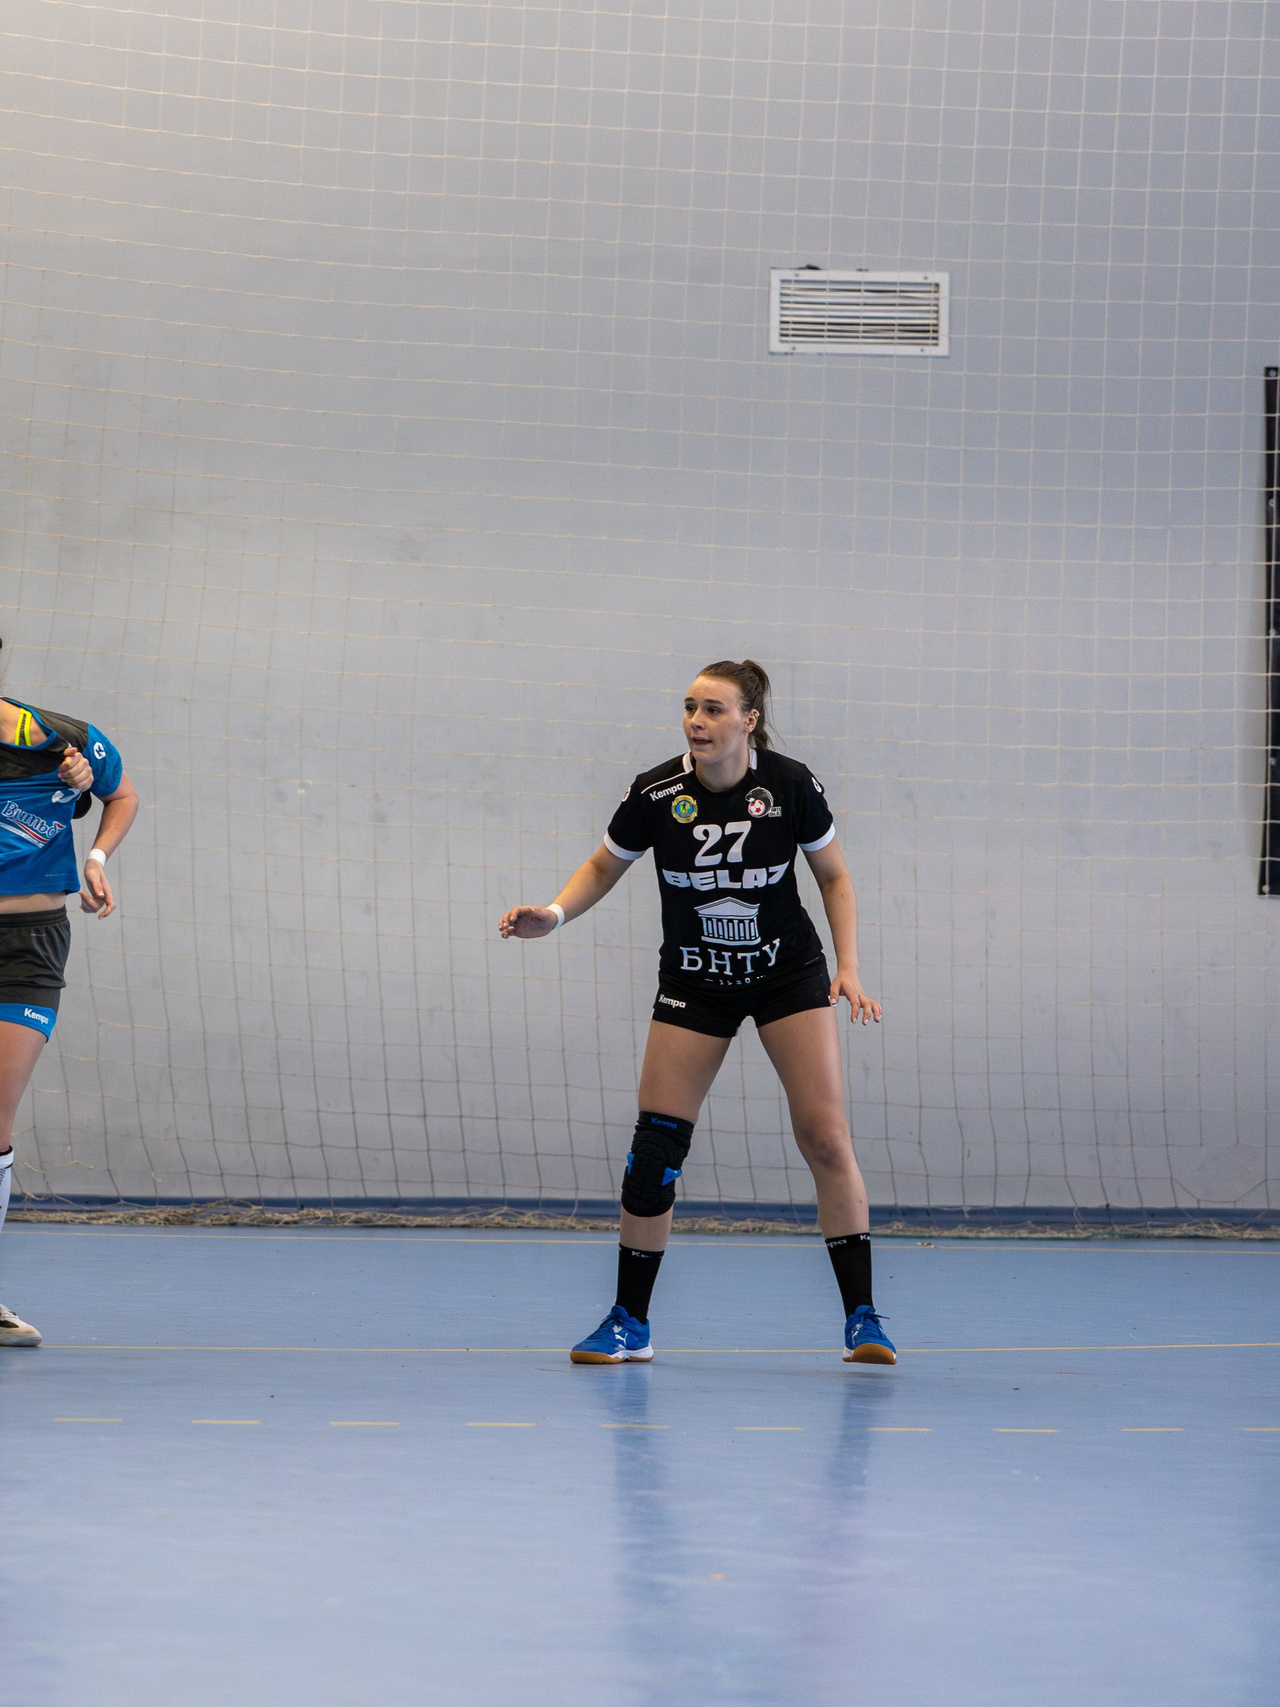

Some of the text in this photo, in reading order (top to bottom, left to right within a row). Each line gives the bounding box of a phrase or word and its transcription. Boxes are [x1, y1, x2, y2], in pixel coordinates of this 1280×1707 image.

[649, 783, 684, 801] Kempa
[692, 820, 752, 867] 27
[679, 938, 781, 976] БНТУ
[658, 993, 686, 1009] Kempa
[24, 1007, 49, 1025] Kempa
